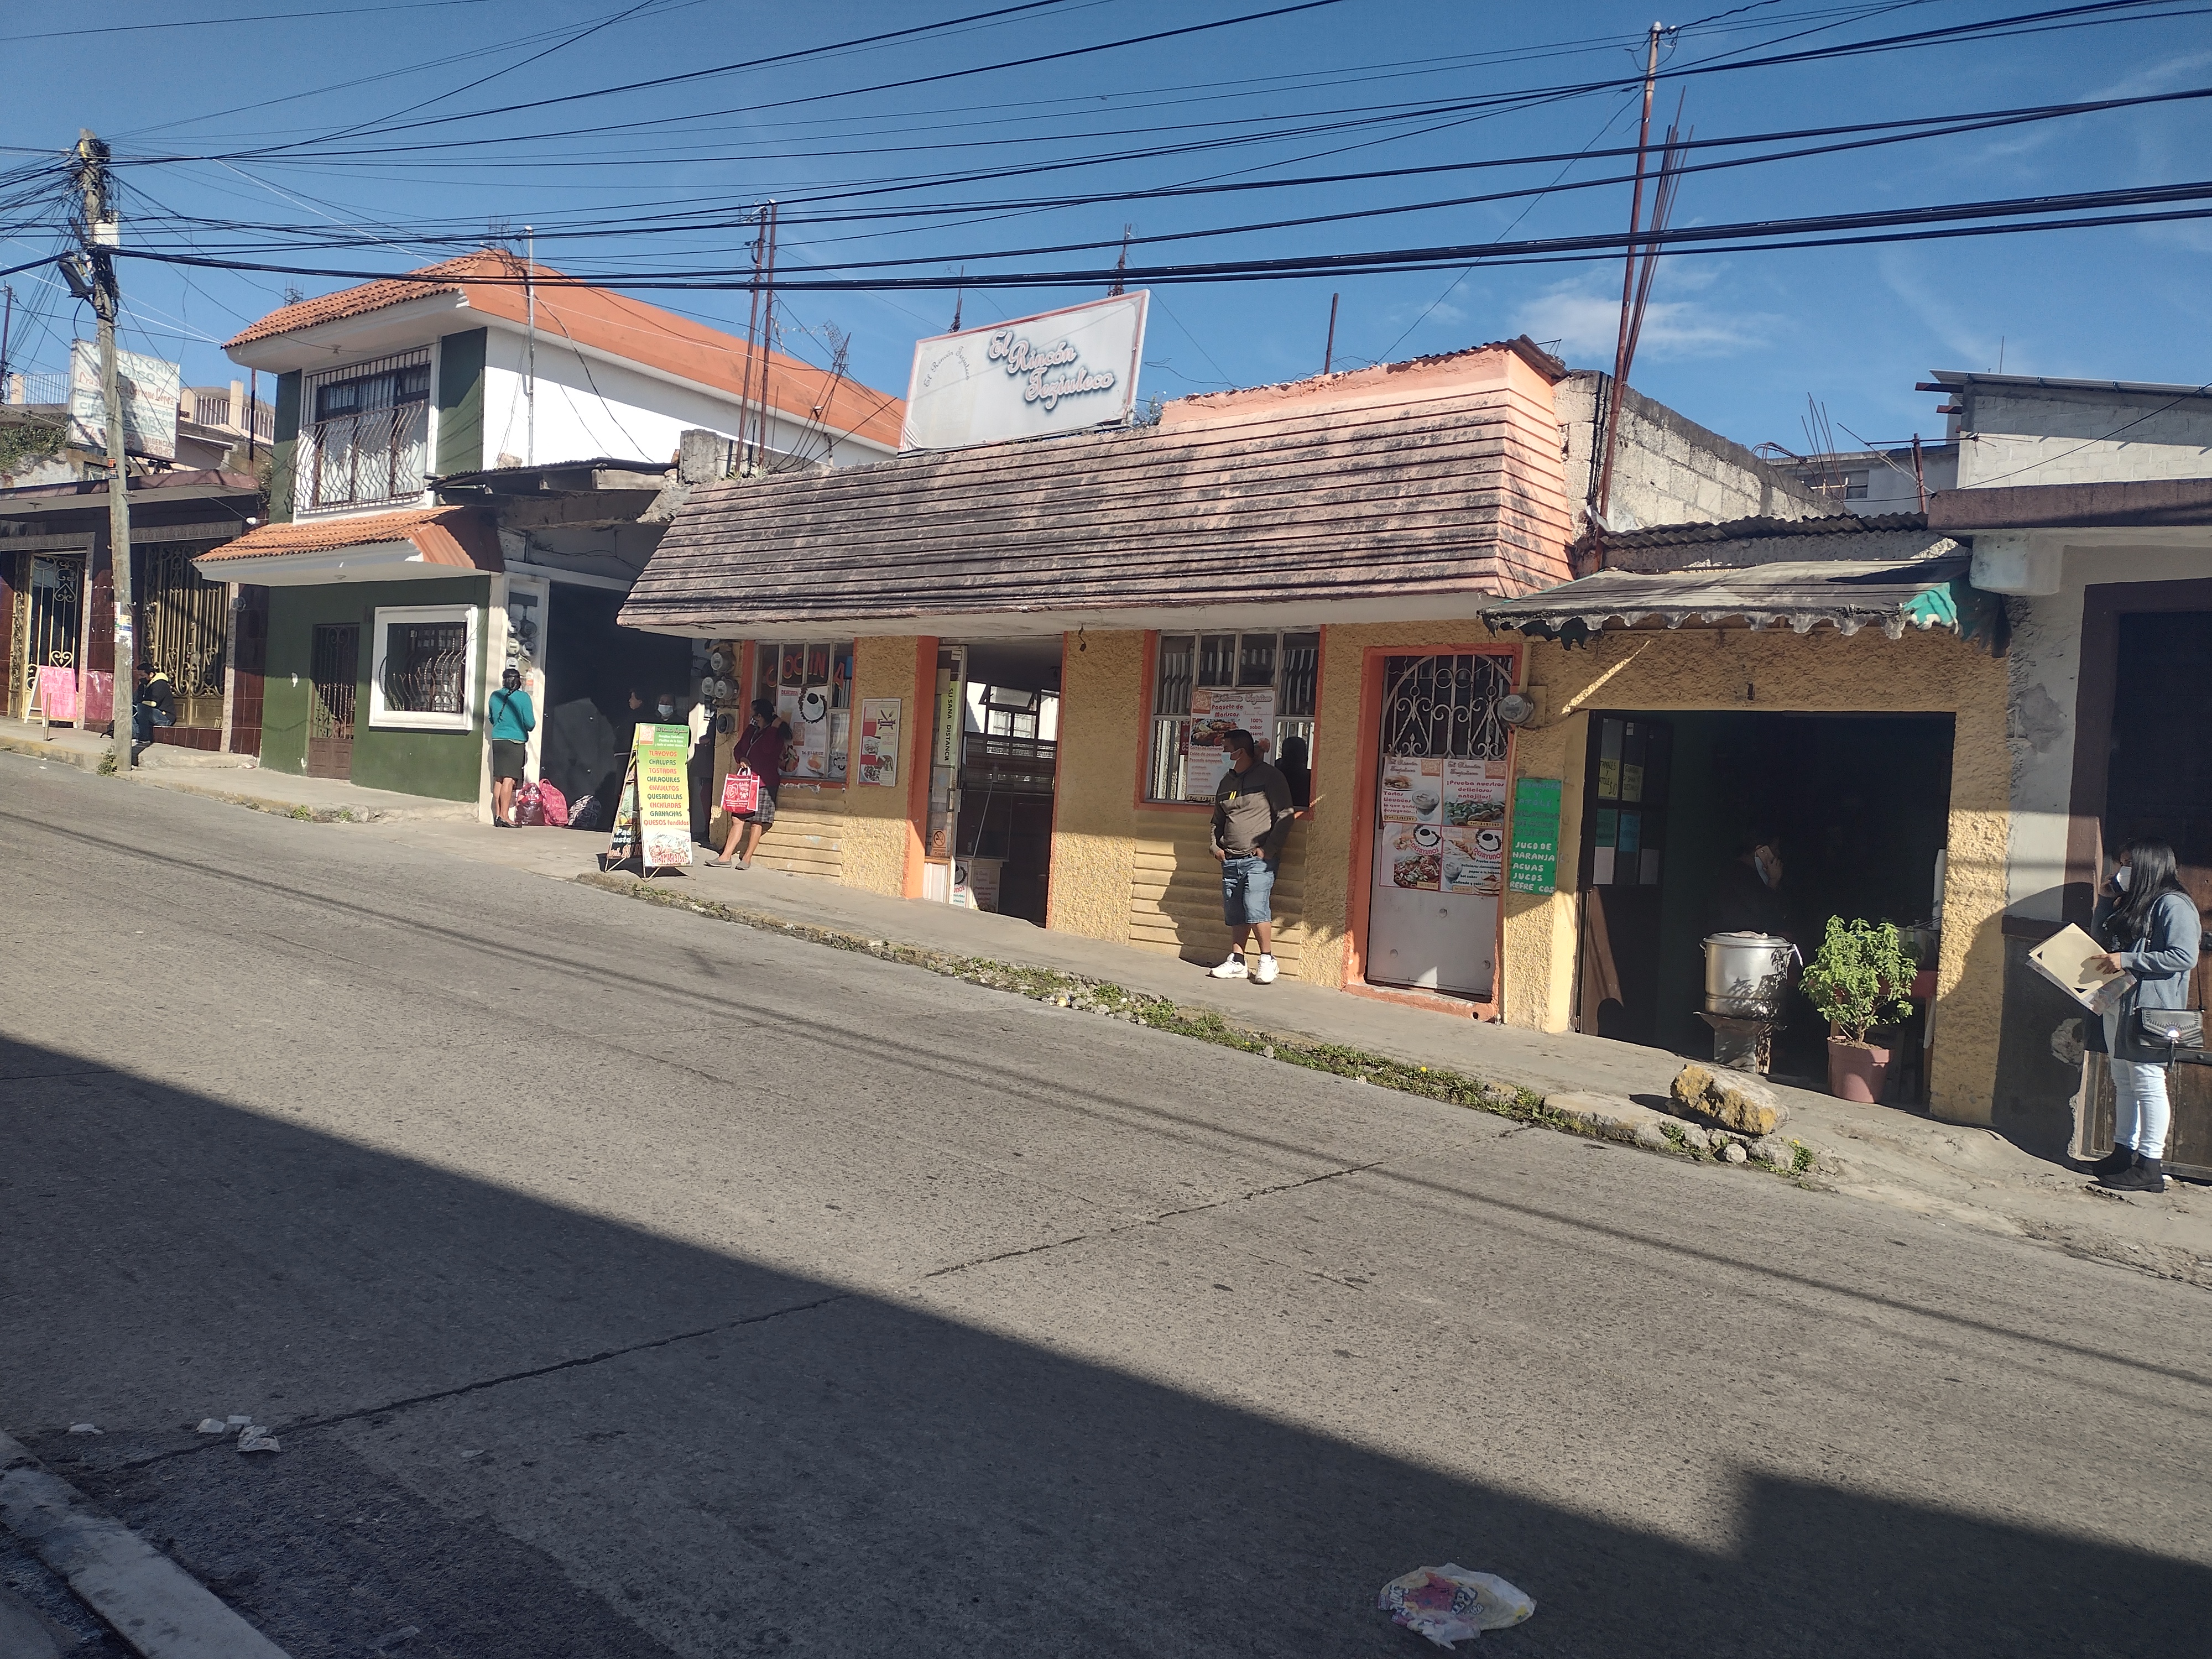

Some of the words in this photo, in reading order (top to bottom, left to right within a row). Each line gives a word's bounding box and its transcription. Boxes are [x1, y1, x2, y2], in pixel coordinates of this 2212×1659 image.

[989, 331, 1013, 359] El
[1008, 340, 1077, 374] Rincón
[924, 374, 932, 387] El
[931, 350, 954, 372] Rincón
[1025, 367, 1115, 409] Teziuteco
[132, 401, 173, 418] Colposcopia
[144, 436, 175, 449] URGENCIAS
[948, 688, 953, 697] SU
[1600, 760, 1616, 770] TAMALES
[1609, 781, 1618, 796] $10
[1518, 798, 1552, 808] ATOLE
[1410, 841, 1439, 856] DESAYUNOS
[1515, 841, 1538, 850] JUGO
[1512, 852, 1555, 862] NARANJA
